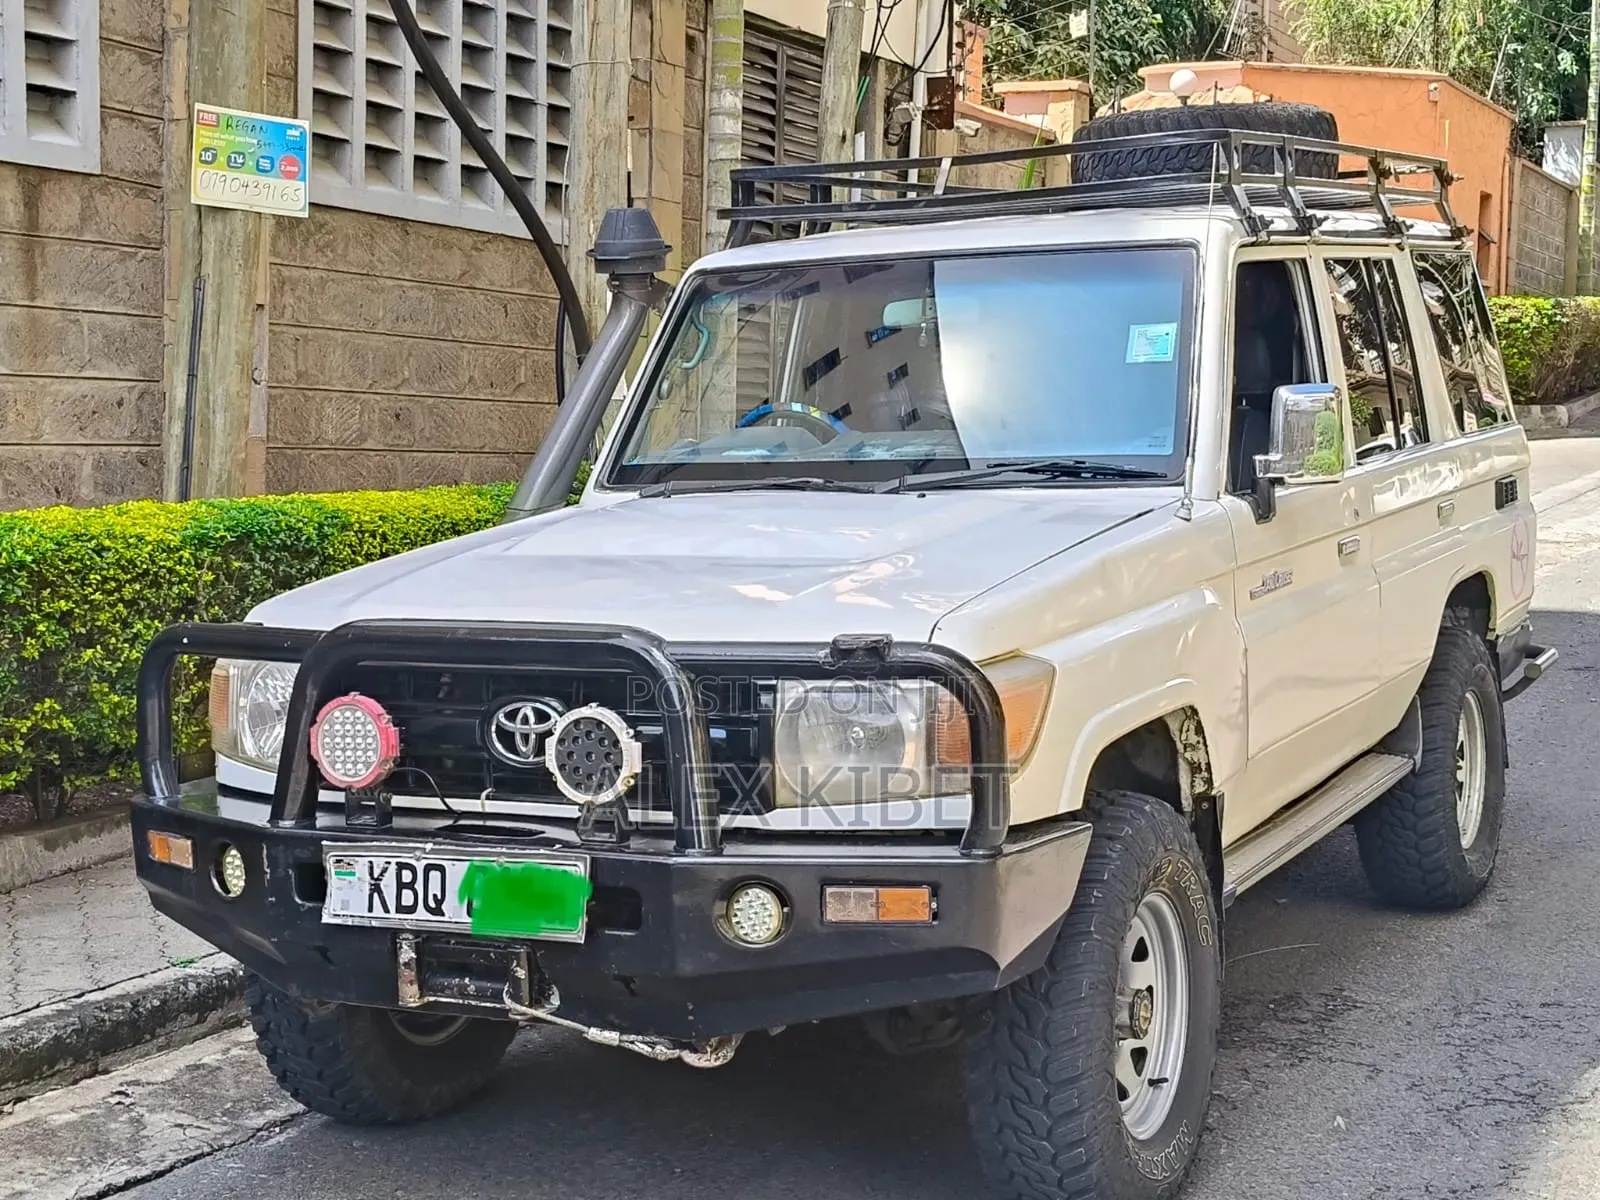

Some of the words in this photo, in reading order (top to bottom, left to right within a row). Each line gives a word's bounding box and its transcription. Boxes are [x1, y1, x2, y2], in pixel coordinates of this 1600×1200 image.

[199, 112, 217, 122] FREE
[225, 116, 268, 134] REGAN
[366, 859, 447, 918] KBQ
[1174, 858, 1213, 946] TRAC
